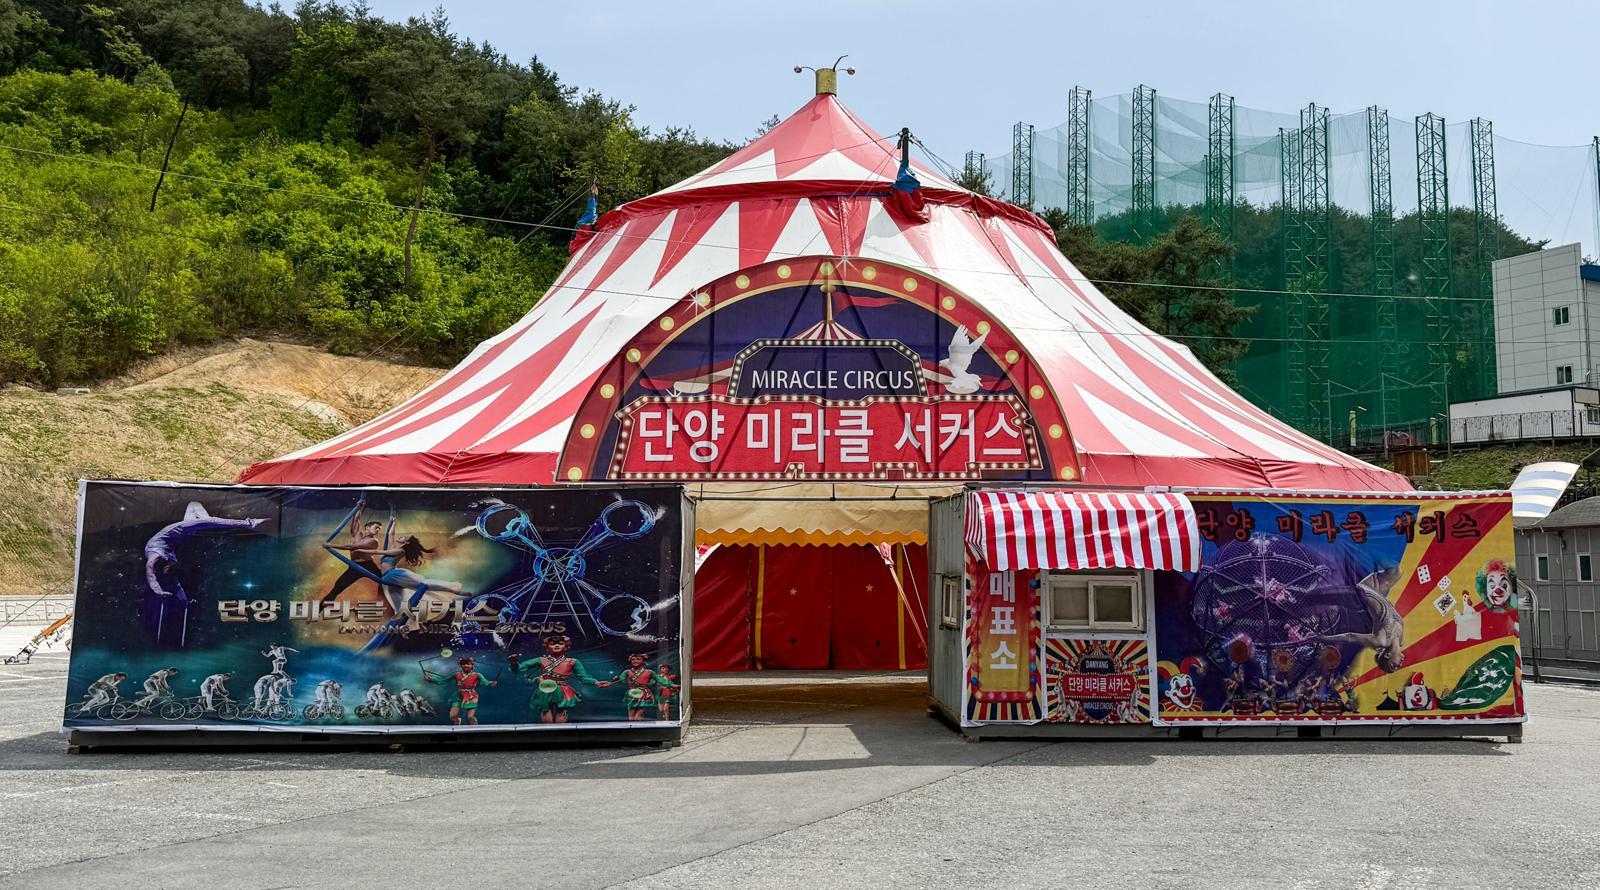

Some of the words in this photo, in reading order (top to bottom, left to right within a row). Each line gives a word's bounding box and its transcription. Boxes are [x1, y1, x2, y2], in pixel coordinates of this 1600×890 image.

[752, 370, 838, 389] MIRACLE
[843, 370, 914, 389] CIRCUS
[639, 409, 725, 462] 단양
[747, 409, 874, 463] 미라클
[894, 408, 1022, 463] 서커스
[1198, 508, 1255, 542] 단양
[1276, 509, 1368, 543] 미라클
[1391, 510, 1481, 543] 서커스
[218, 599, 282, 622] 단양
[288, 599, 388, 622] 미라클
[394, 599, 500, 623] 서커스
[989, 570, 1017, 670] 매표소
[1085, 660, 1109, 669] DANYANG
[1068, 677, 1084, 692] 단양
[1085, 677, 1107, 692] 미라클
[1108, 677, 1131, 692] 서커스
